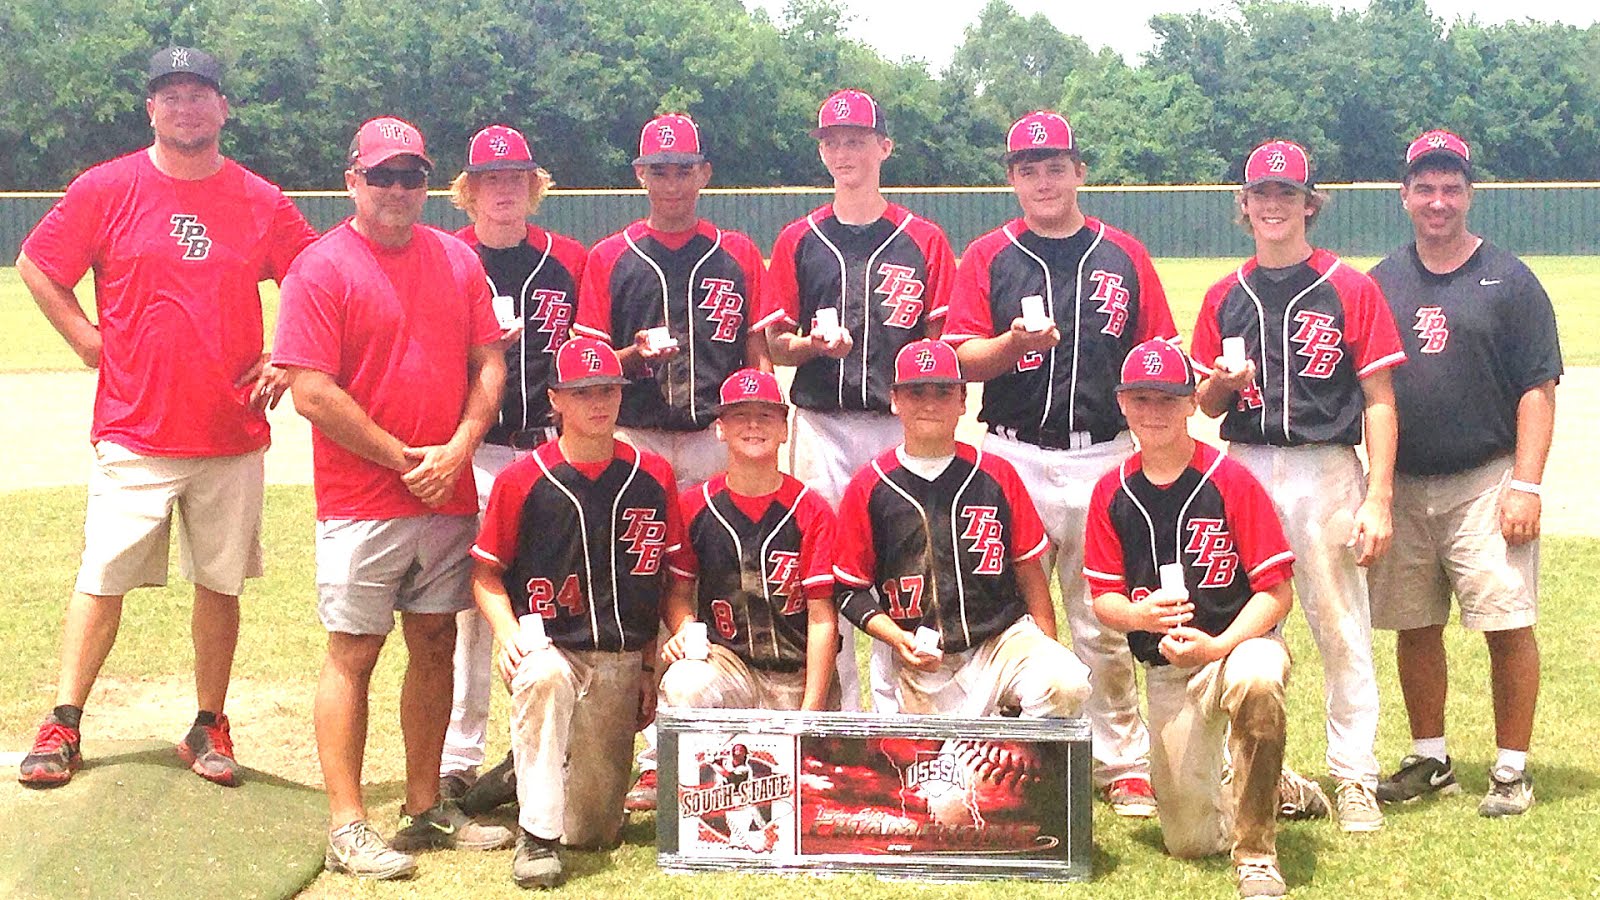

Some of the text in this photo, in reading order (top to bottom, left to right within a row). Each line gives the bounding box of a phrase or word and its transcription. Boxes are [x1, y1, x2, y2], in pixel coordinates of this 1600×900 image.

[169, 214, 212, 260] TPB
[698, 278, 743, 342] TPB
[874, 263, 924, 329] TPB
[1089, 270, 1129, 339] TPB
[530, 289, 571, 353] TPB
[1290, 309, 1344, 378] TPB
[1413, 306, 1449, 354] TPB
[580, 348, 603, 371] TPB
[914, 350, 937, 372] TPB
[1142, 351, 1163, 376] TPB
[619, 508, 666, 575] TPB
[960, 505, 1005, 575] TPB
[1185, 518, 1238, 589] TPB
[527, 574, 584, 620] 24
[711, 599, 737, 640] 8
[882, 574, 924, 619] 17
[682, 774, 790, 817] SOUTH STATE
[906, 759, 966, 790] USSSA
